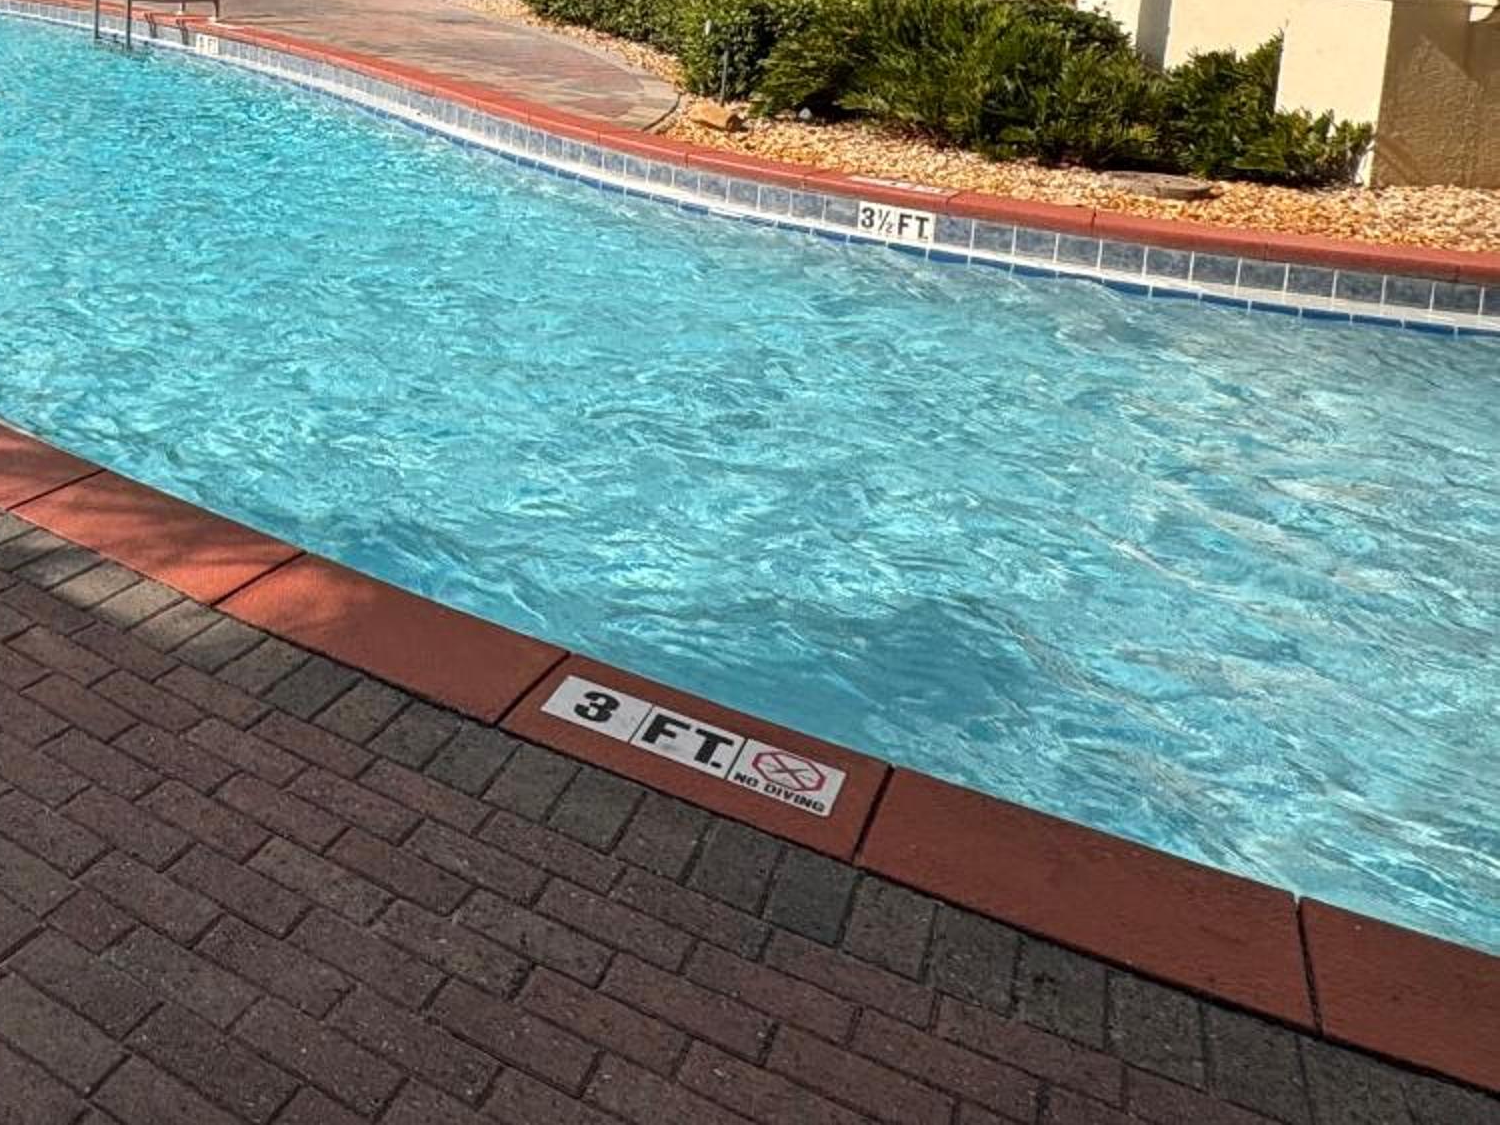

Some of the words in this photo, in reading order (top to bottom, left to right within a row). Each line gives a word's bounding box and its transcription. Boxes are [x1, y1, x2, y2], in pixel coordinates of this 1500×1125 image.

[573, 690, 621, 723] 3
[640, 713, 734, 769] FT.
[733, 772, 759, 787] NO
[763, 783, 826, 812] DIVING
